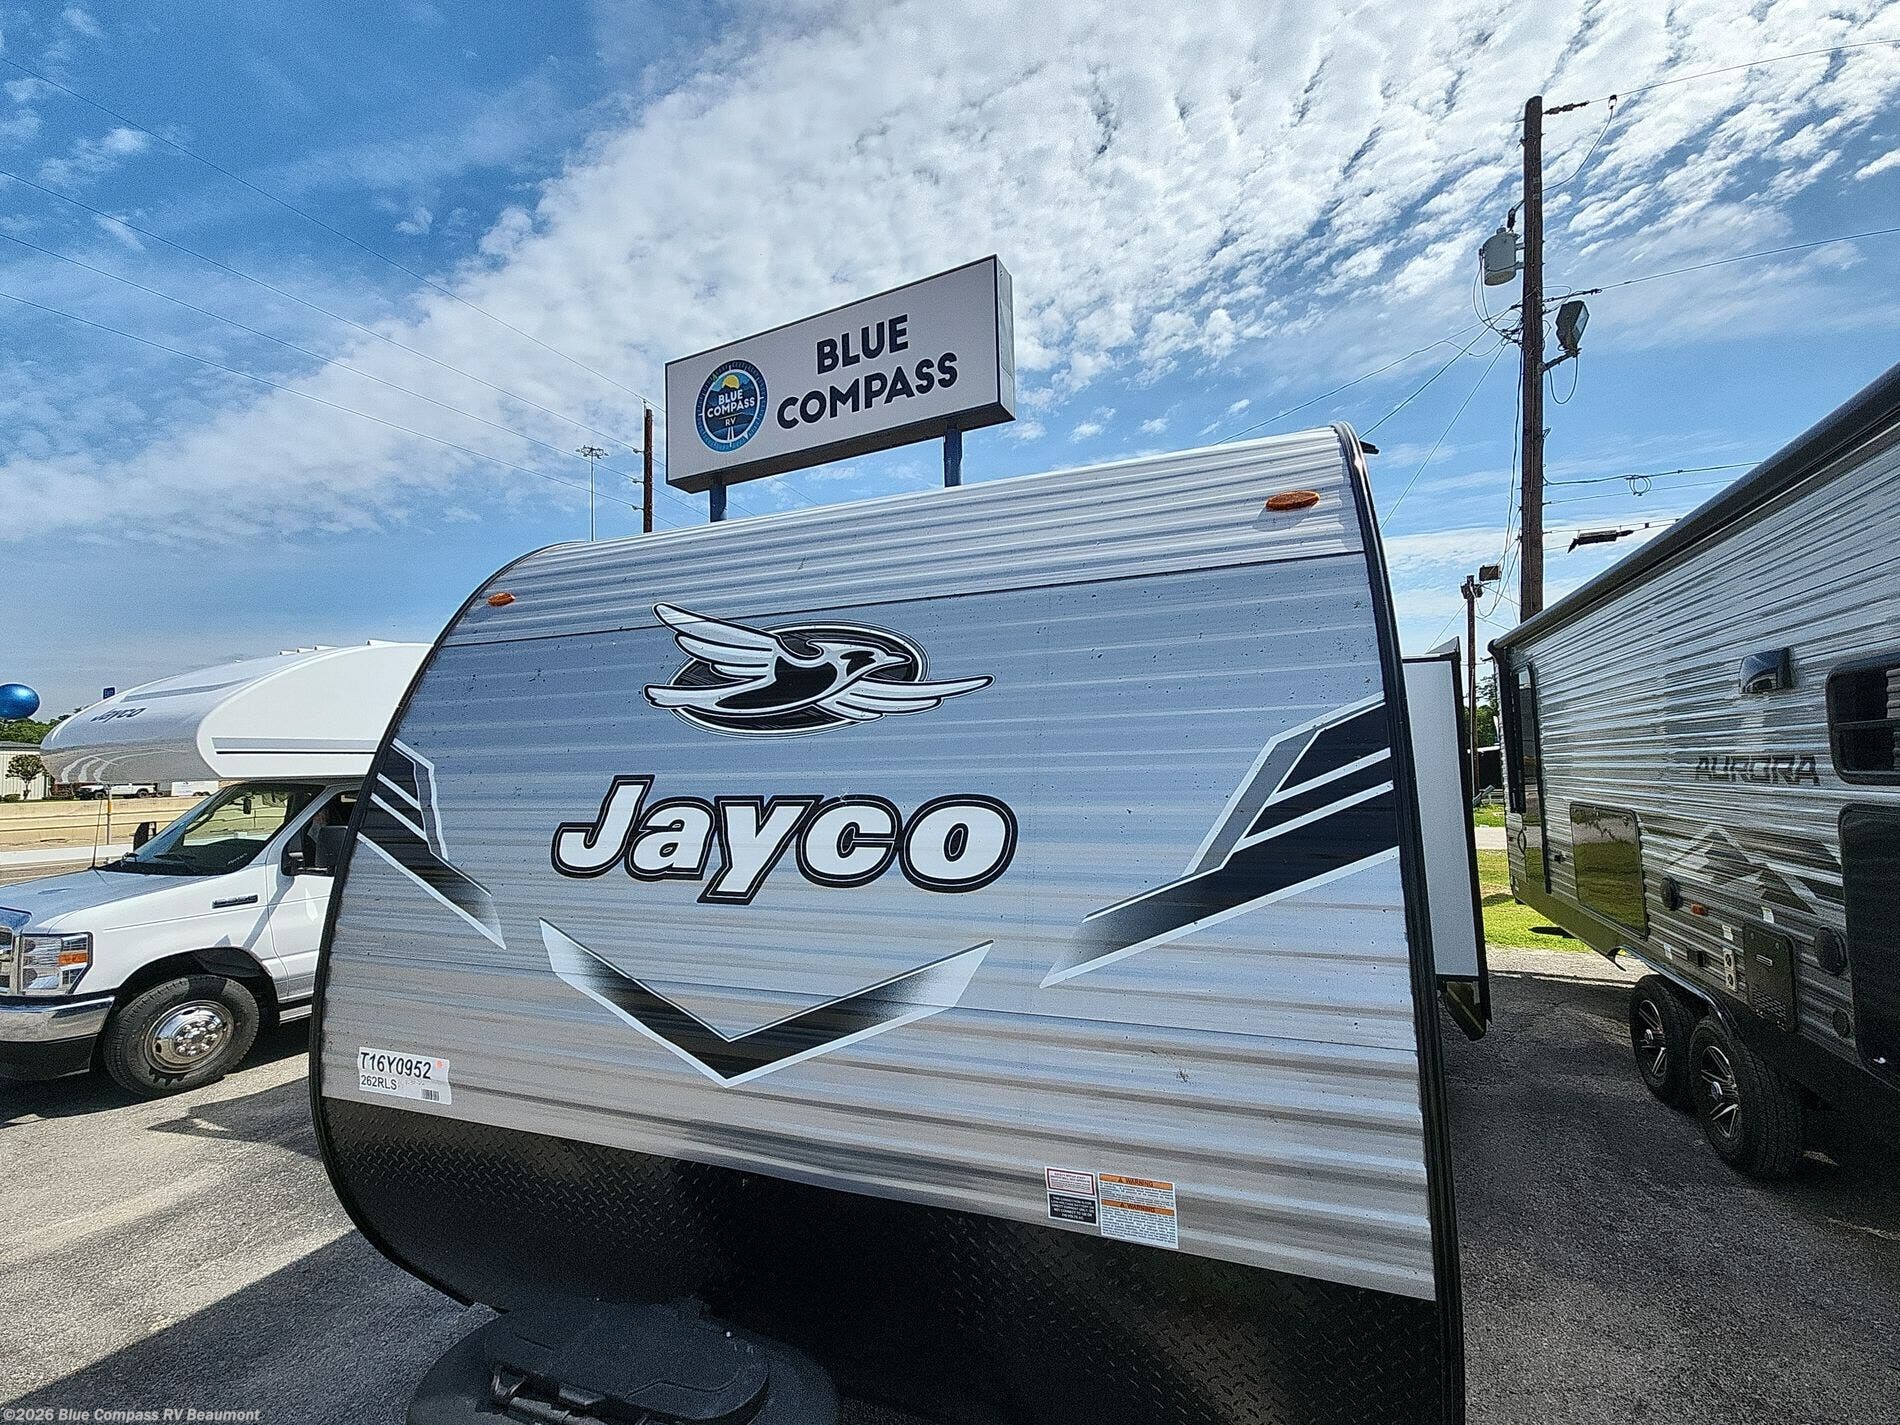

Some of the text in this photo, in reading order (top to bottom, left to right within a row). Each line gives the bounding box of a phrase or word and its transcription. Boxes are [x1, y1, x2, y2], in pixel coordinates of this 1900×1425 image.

[816, 313, 909, 375] BLUE
[718, 389, 743, 405] BLUE
[777, 352, 958, 430] COMPASS
[707, 397, 755, 418] COMPASS
[725, 417, 736, 426] RV
[1696, 754, 1819, 786] AURORA
[550, 774, 1019, 905] Jayco
[360, 1052, 432, 1080] T16Y0952
[360, 1074, 397, 1091] 262RLS
[1126, 1178, 1154, 1188] WARNING
